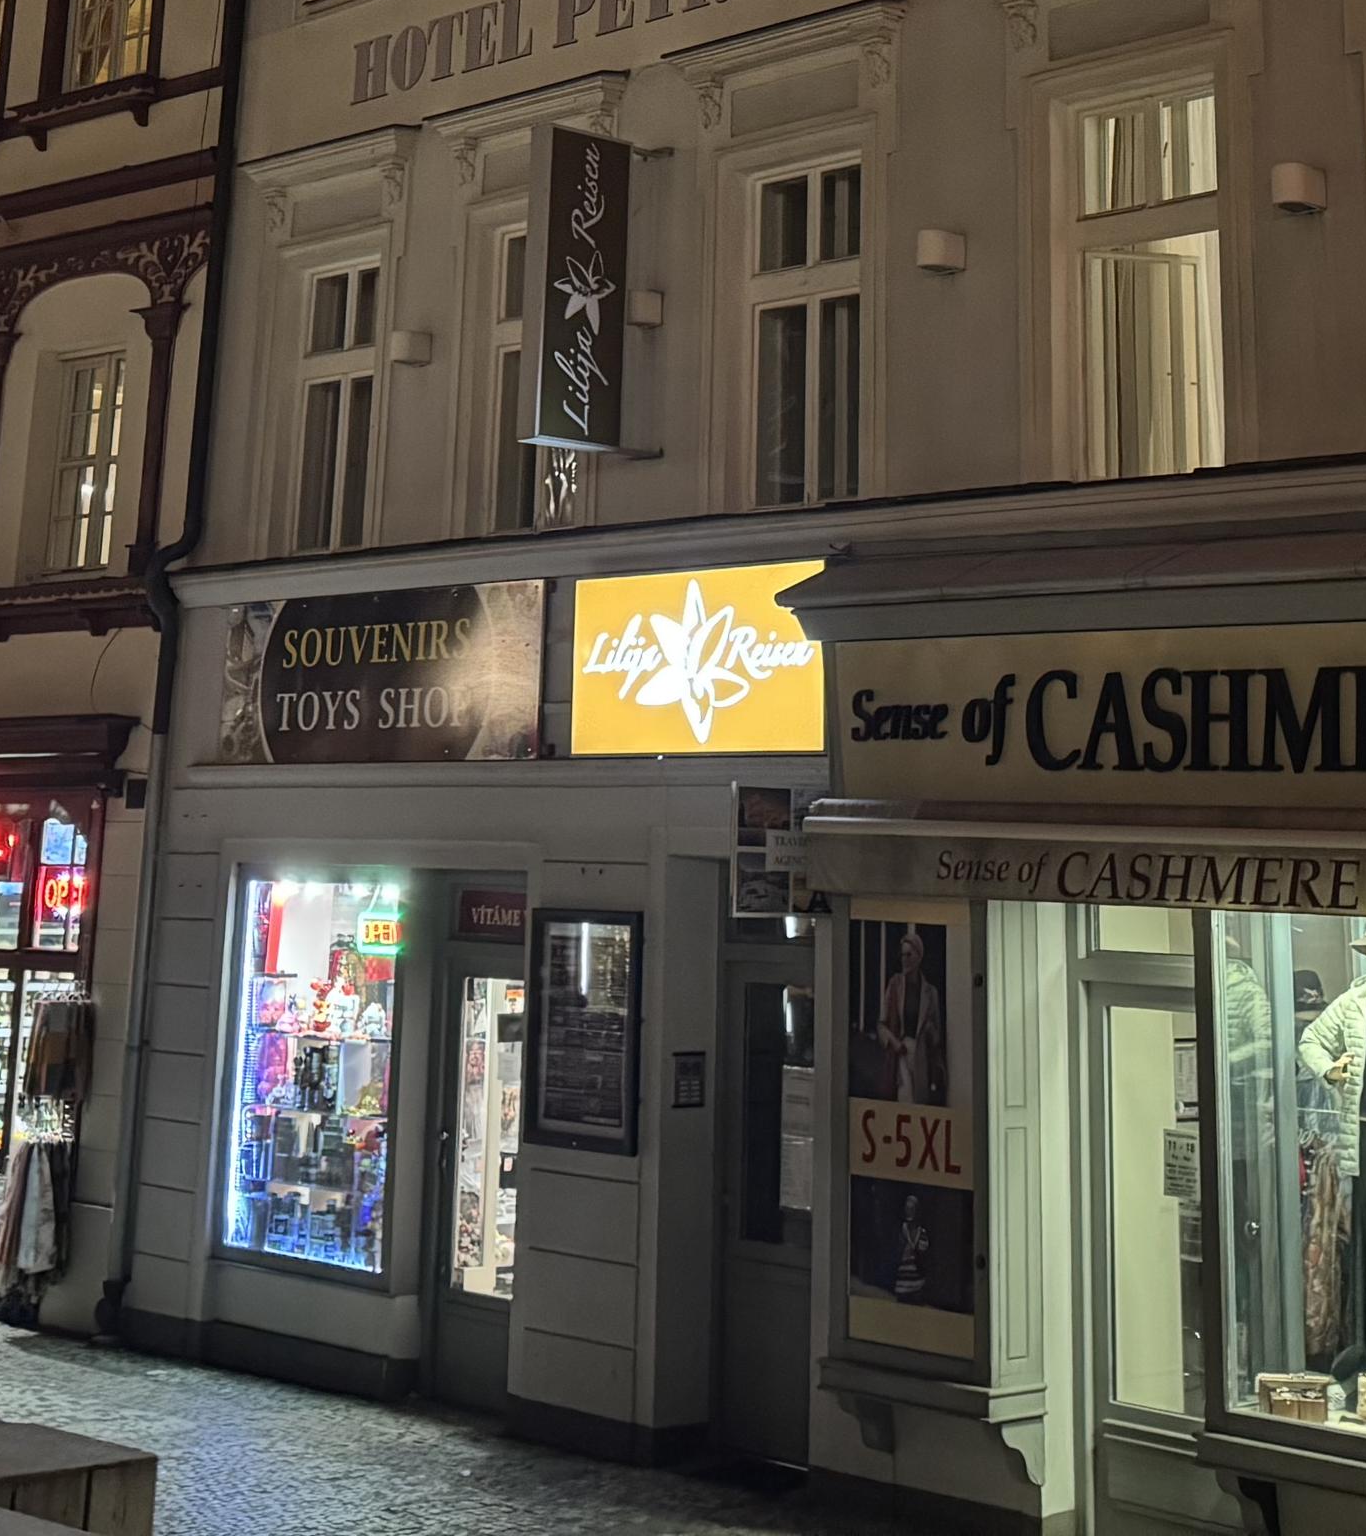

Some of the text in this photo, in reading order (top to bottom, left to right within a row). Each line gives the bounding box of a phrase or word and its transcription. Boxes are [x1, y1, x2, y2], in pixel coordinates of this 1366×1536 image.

[554, 142, 609, 437] Lilija Reisen
[283, 617, 472, 669] SOUVENIRS
[726, 625, 815, 680] Reisen
[276, 685, 473, 732] TOYS SHOP
[850, 689, 950, 743] Sense
[961, 673, 1016, 766] of
[936, 849, 1361, 912] Sense of CASHMERE
[471, 905, 521, 927] VÍTÁME
